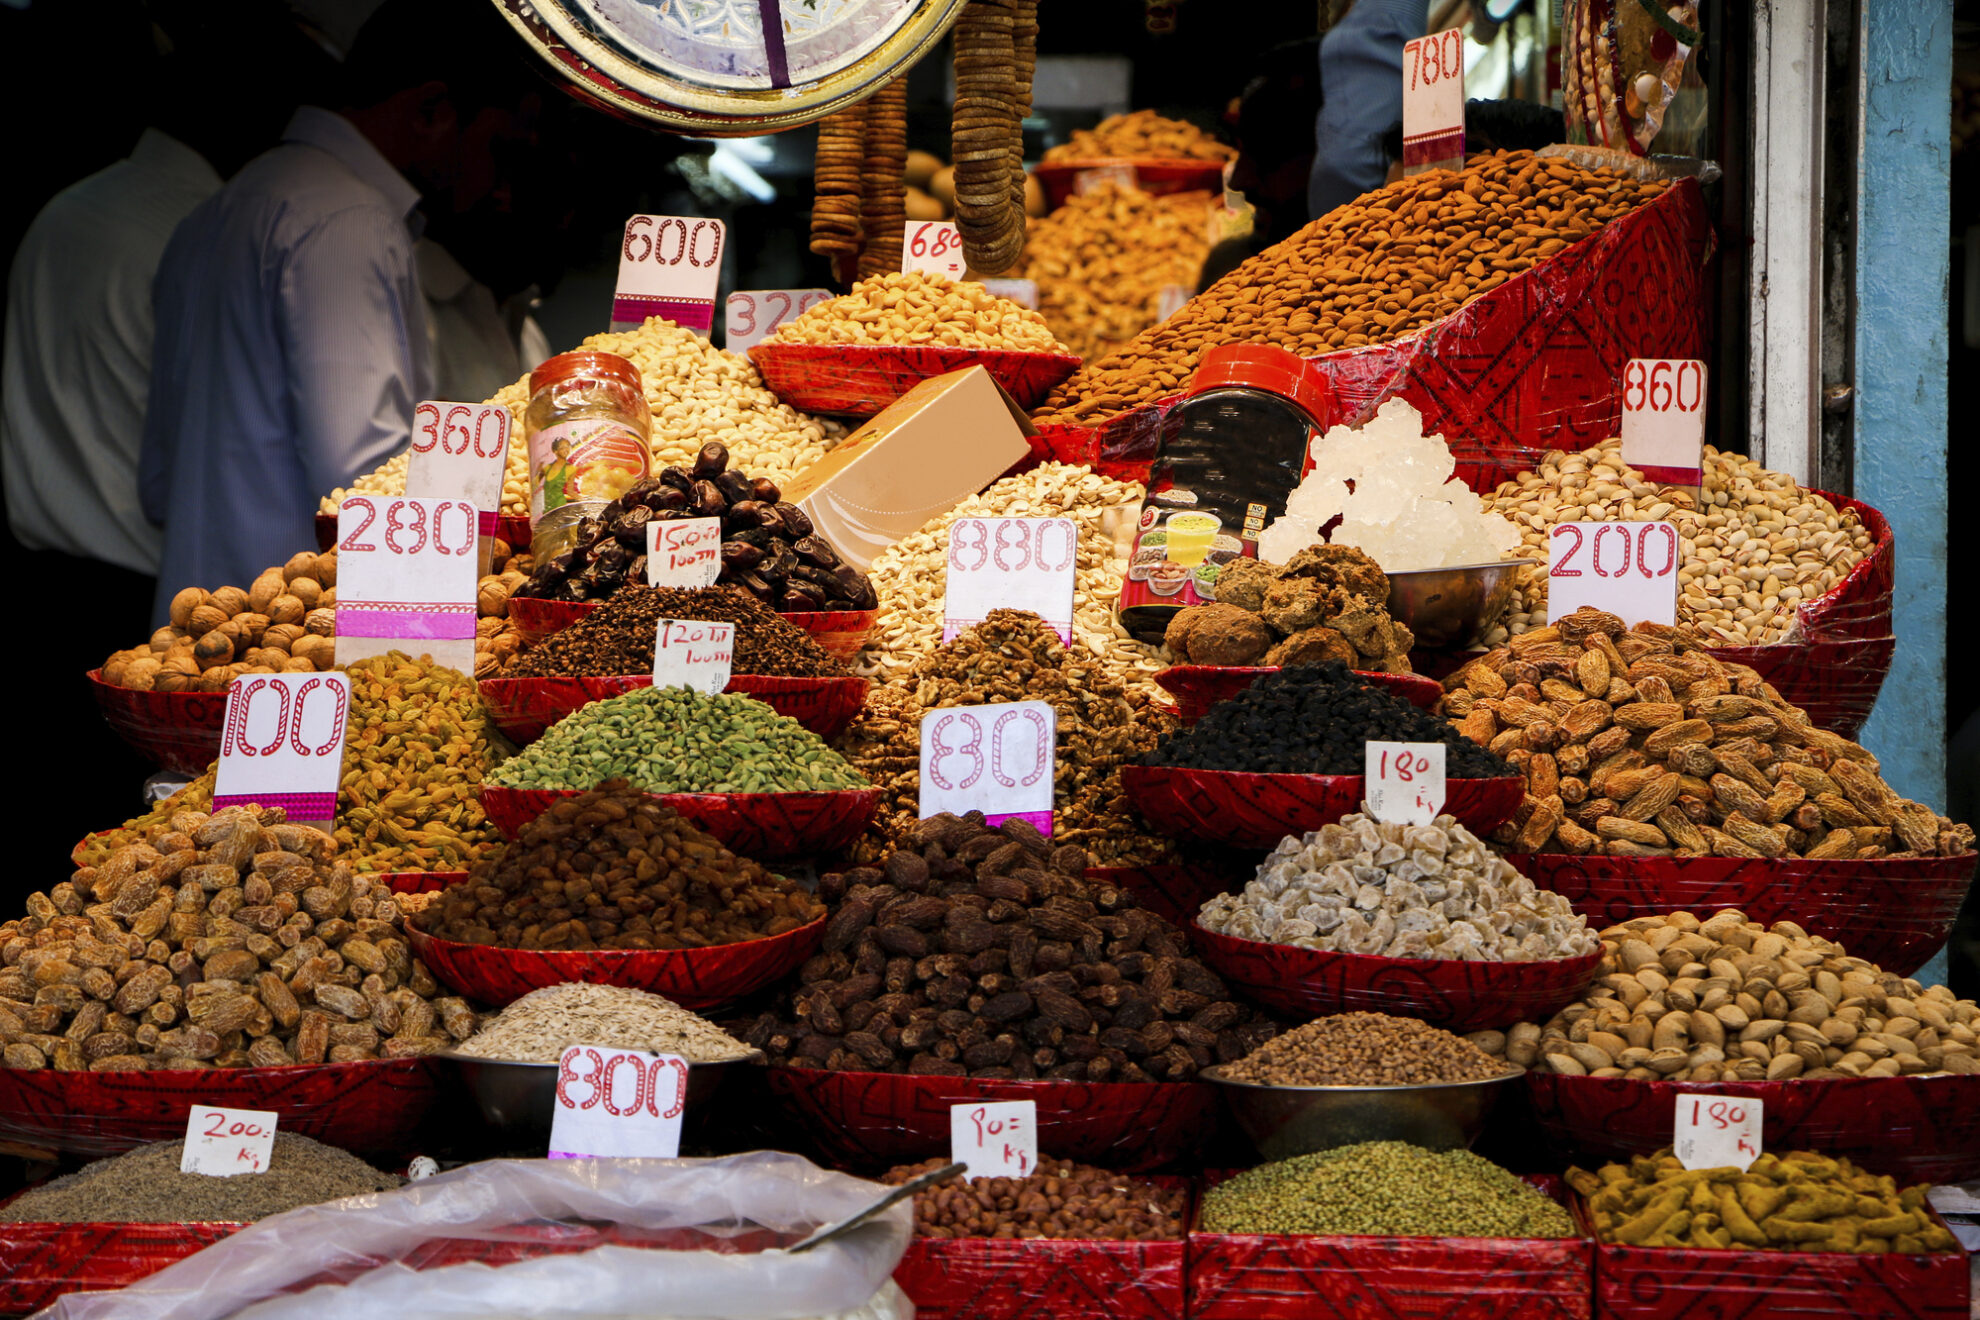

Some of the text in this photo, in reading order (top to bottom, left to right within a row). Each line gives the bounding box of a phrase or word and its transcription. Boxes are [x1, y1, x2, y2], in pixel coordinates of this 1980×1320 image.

[1405, 30, 1460, 91] 780
[624, 216, 721, 268] 600
[911, 222, 963, 257] 680
[1624, 361, 1702, 413] 860
[412, 403, 506, 459] 360
[339, 497, 475, 557] 280
[949, 519, 1074, 573] 880
[1550, 523, 1676, 579] 200
[223, 677, 346, 758] 100
[929, 708, 1047, 791] 80
[1380, 750, 1429, 782] 180
[557, 1045, 688, 1119] 800
[1692, 1100, 1746, 1130] 180
